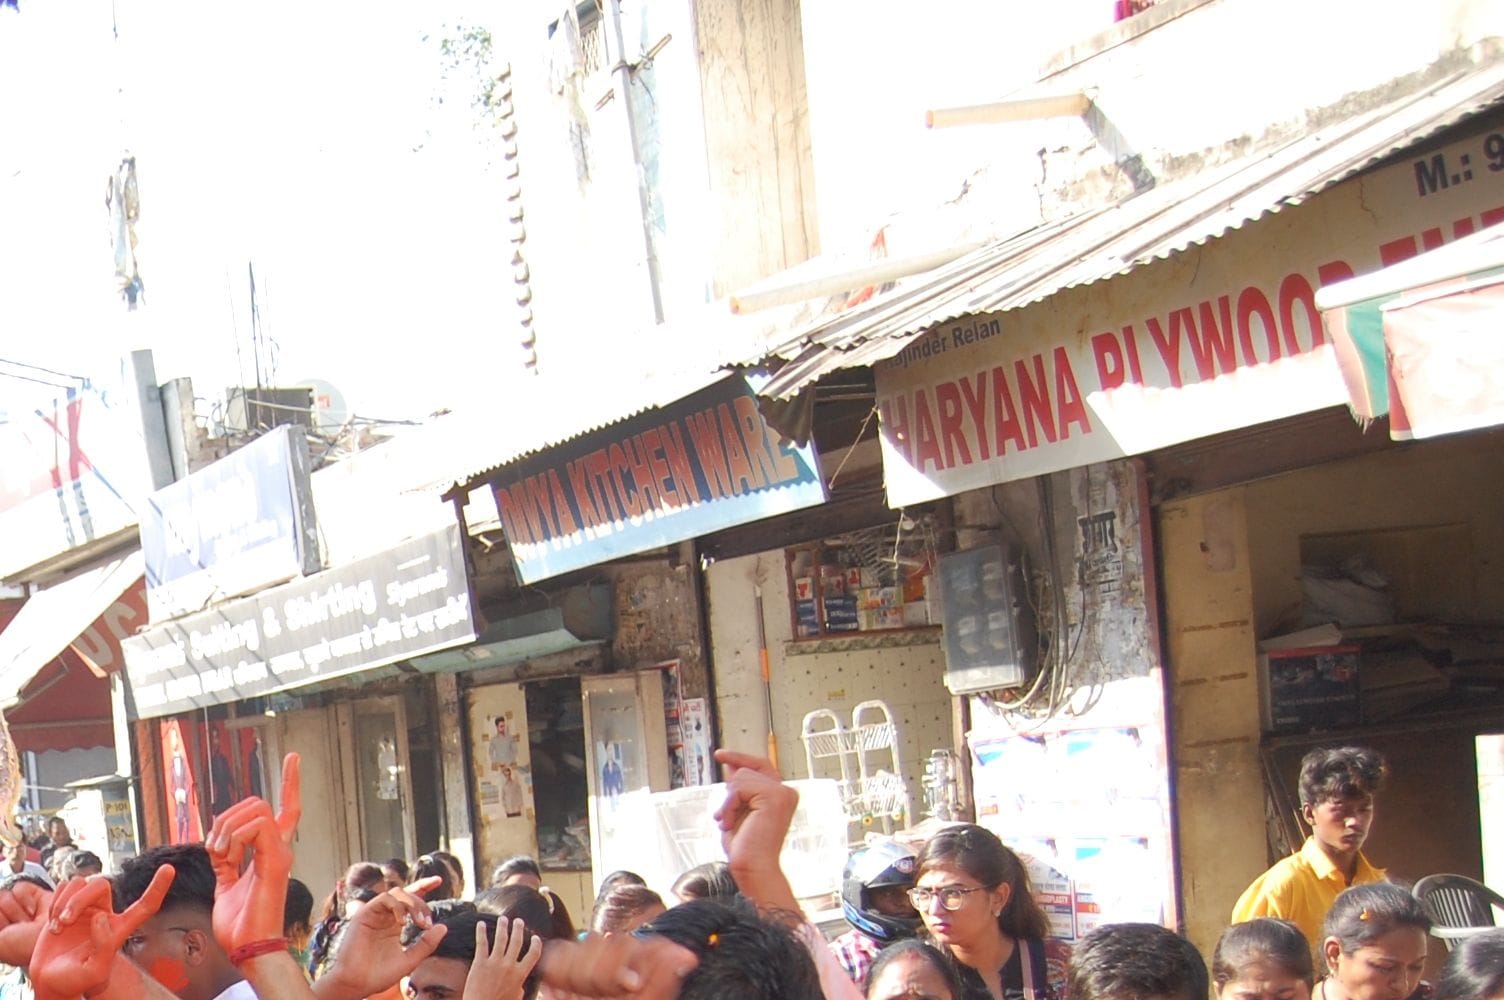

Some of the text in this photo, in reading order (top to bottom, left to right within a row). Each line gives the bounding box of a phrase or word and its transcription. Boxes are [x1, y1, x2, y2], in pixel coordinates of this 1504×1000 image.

[952, 319, 1001, 348] Relan
[881, 346, 1093, 474] HARYANA
[497, 395, 798, 556] DIVYA KITCHEN WARE
